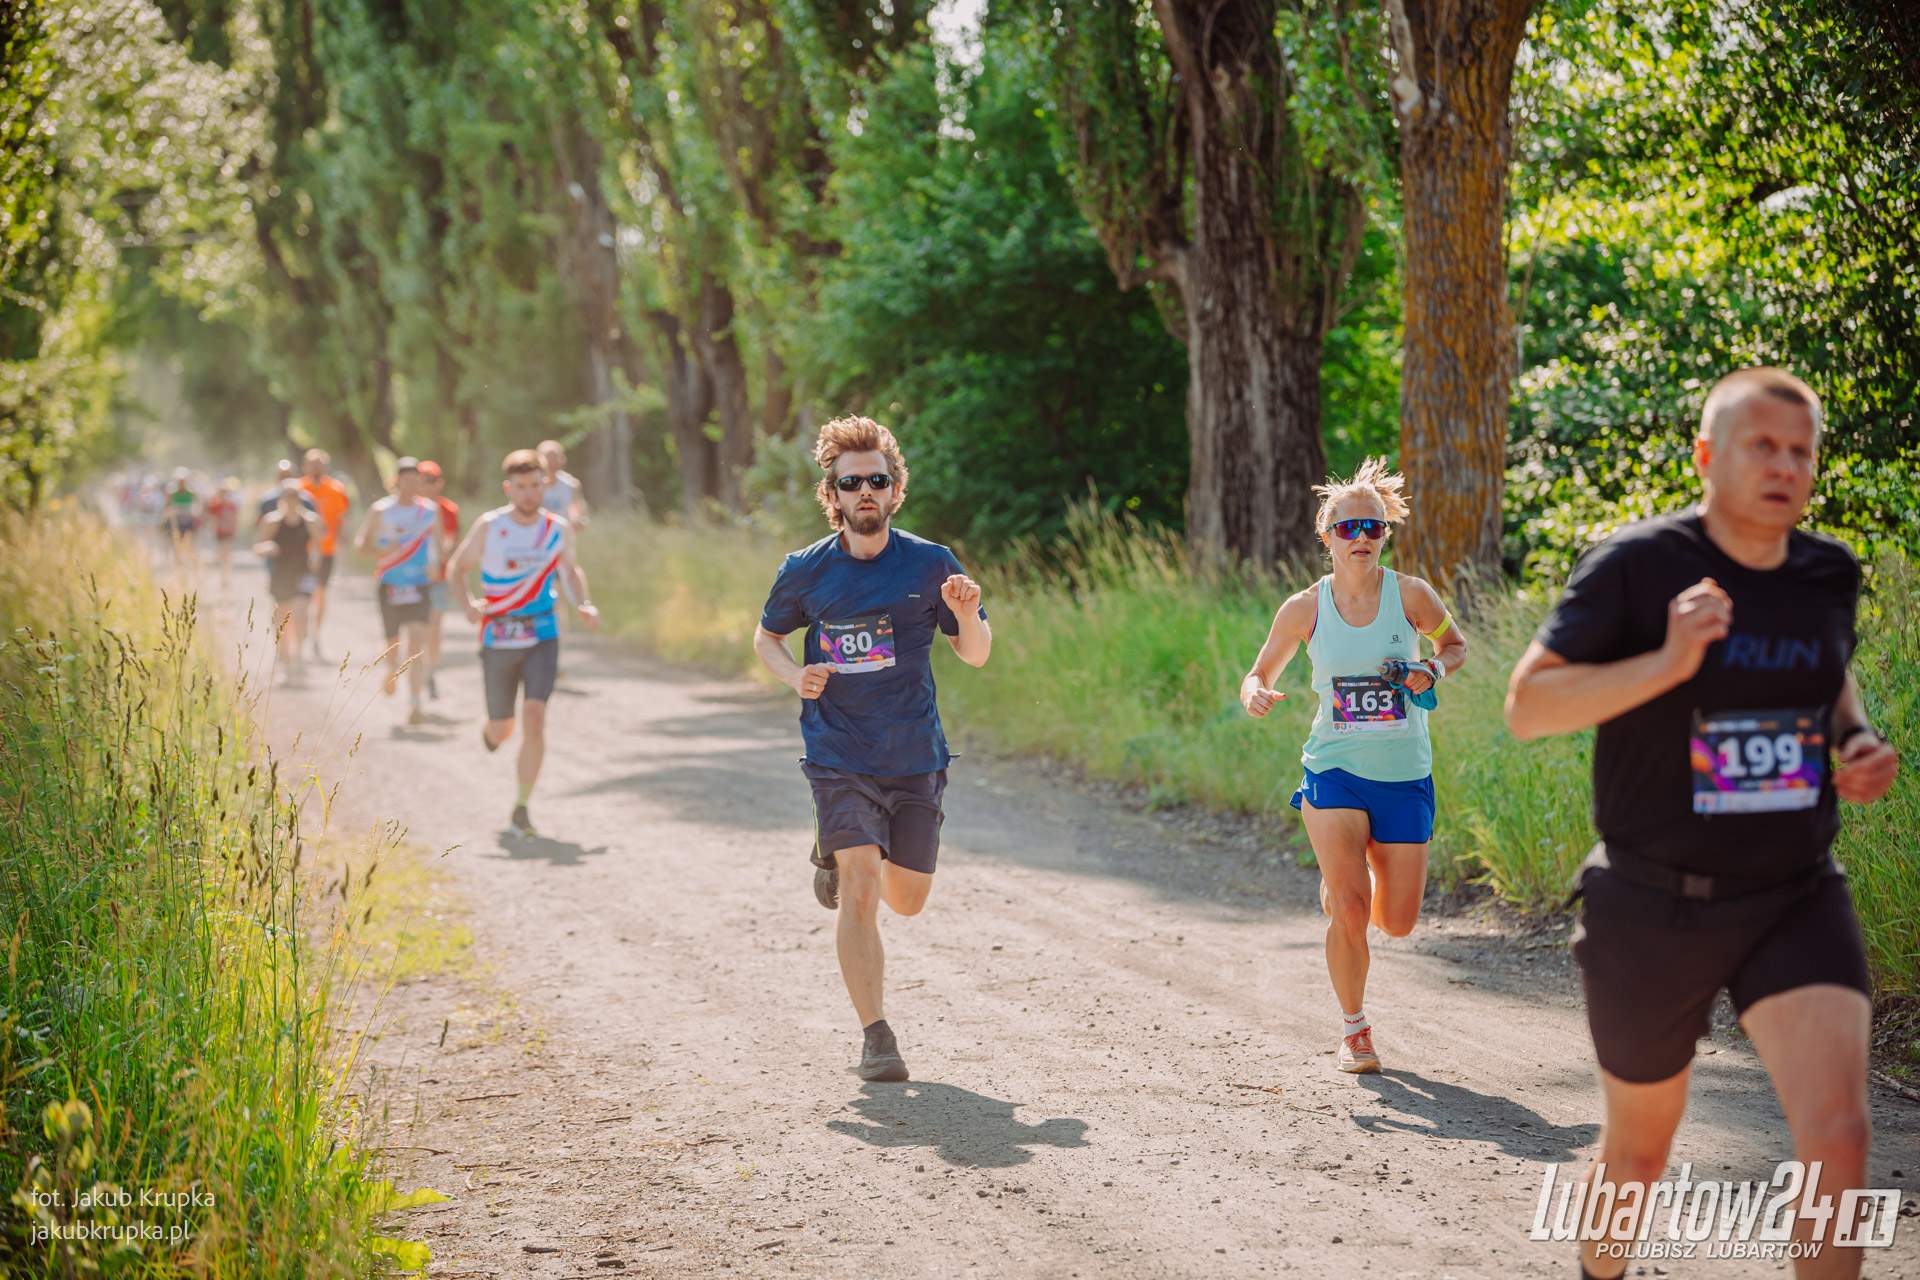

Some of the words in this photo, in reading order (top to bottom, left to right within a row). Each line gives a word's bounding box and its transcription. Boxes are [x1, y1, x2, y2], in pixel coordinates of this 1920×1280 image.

[841, 631, 873, 655] 80
[1723, 633, 1822, 669] RUN
[1346, 690, 1393, 712] 163
[1718, 733, 1803, 778] 199
